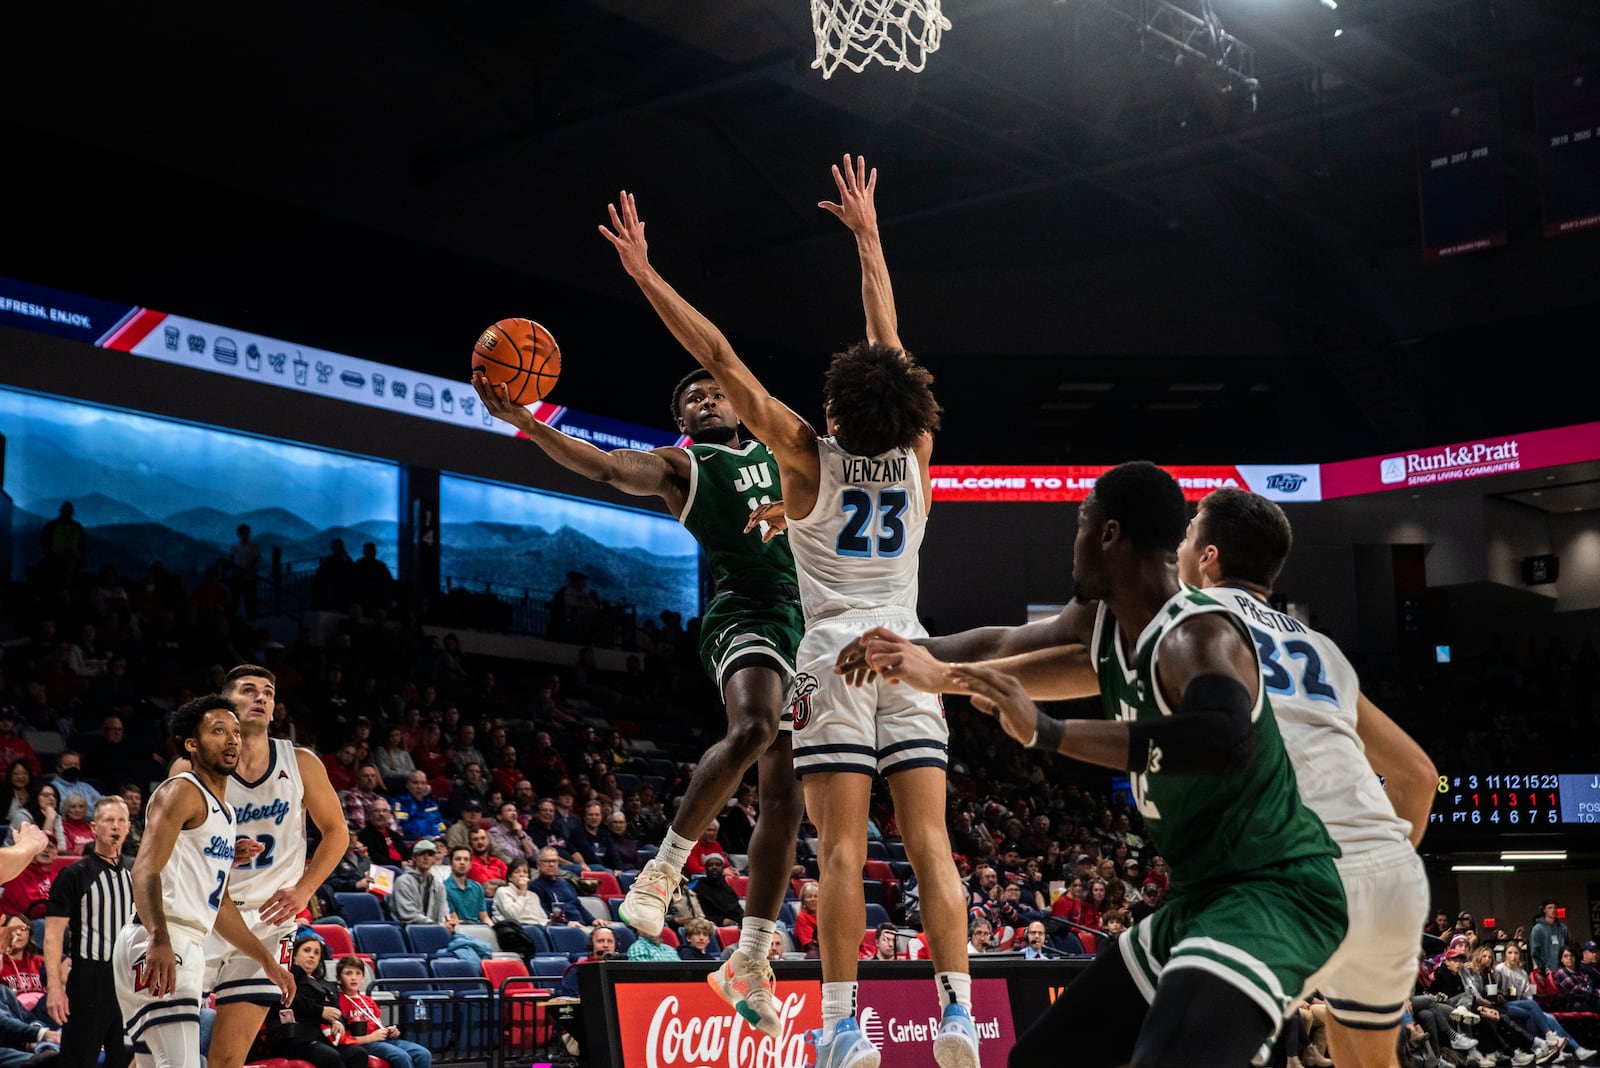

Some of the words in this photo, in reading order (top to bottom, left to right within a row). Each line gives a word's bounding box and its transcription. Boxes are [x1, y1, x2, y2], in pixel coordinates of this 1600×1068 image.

[1573, 128, 1592, 142] 2020
[0, 296, 49, 319] EFRESH.
[50, 307, 92, 329] ENJOY.
[561, 424, 592, 440] REFUEL.
[593, 431, 629, 449] REFRESH.
[1407, 440, 1519, 473] Runk&Pratt
[734, 462, 773, 493] JU
[842, 457, 907, 483] VENZANT
[1030, 477, 1062, 489] TO
[1408, 473, 1436, 486] SENIOR
[1437, 470, 1463, 482] LIVING
[1464, 460, 1521, 477] COMMUNITIES
[836, 487, 909, 558] 23
[1234, 595, 1307, 635] PRESTON
[1249, 624, 1341, 709] 32
[1437, 775, 1450, 793] 8
[1453, 778, 1461, 787] #
[1468, 775, 1478, 789] 3
[1485, 775, 1500, 789] 11
[1503, 775, 1521, 789] 12
[1522, 775, 1540, 789] 15
[1541, 775, 1559, 789] 23
[233, 799, 290, 826] iberty
[1455, 794, 1462, 805] F
[1472, 793, 1479, 807] 1
[1491, 793, 1498, 807] 1
[1508, 793, 1518, 807] 3
[1529, 793, 1537, 807] 1
[1548, 793, 1556, 807] 1
[1452, 811, 1467, 822] PT
[1471, 810, 1481, 824] 6
[1490, 810, 1500, 823] 4
[1509, 810, 1519, 824] 6
[1529, 810, 1537, 823] 7
[1548, 810, 1558, 824] 5
[646, 992, 808, 1068] Coca-Cola
[888, 1017, 928, 1043] Carter
